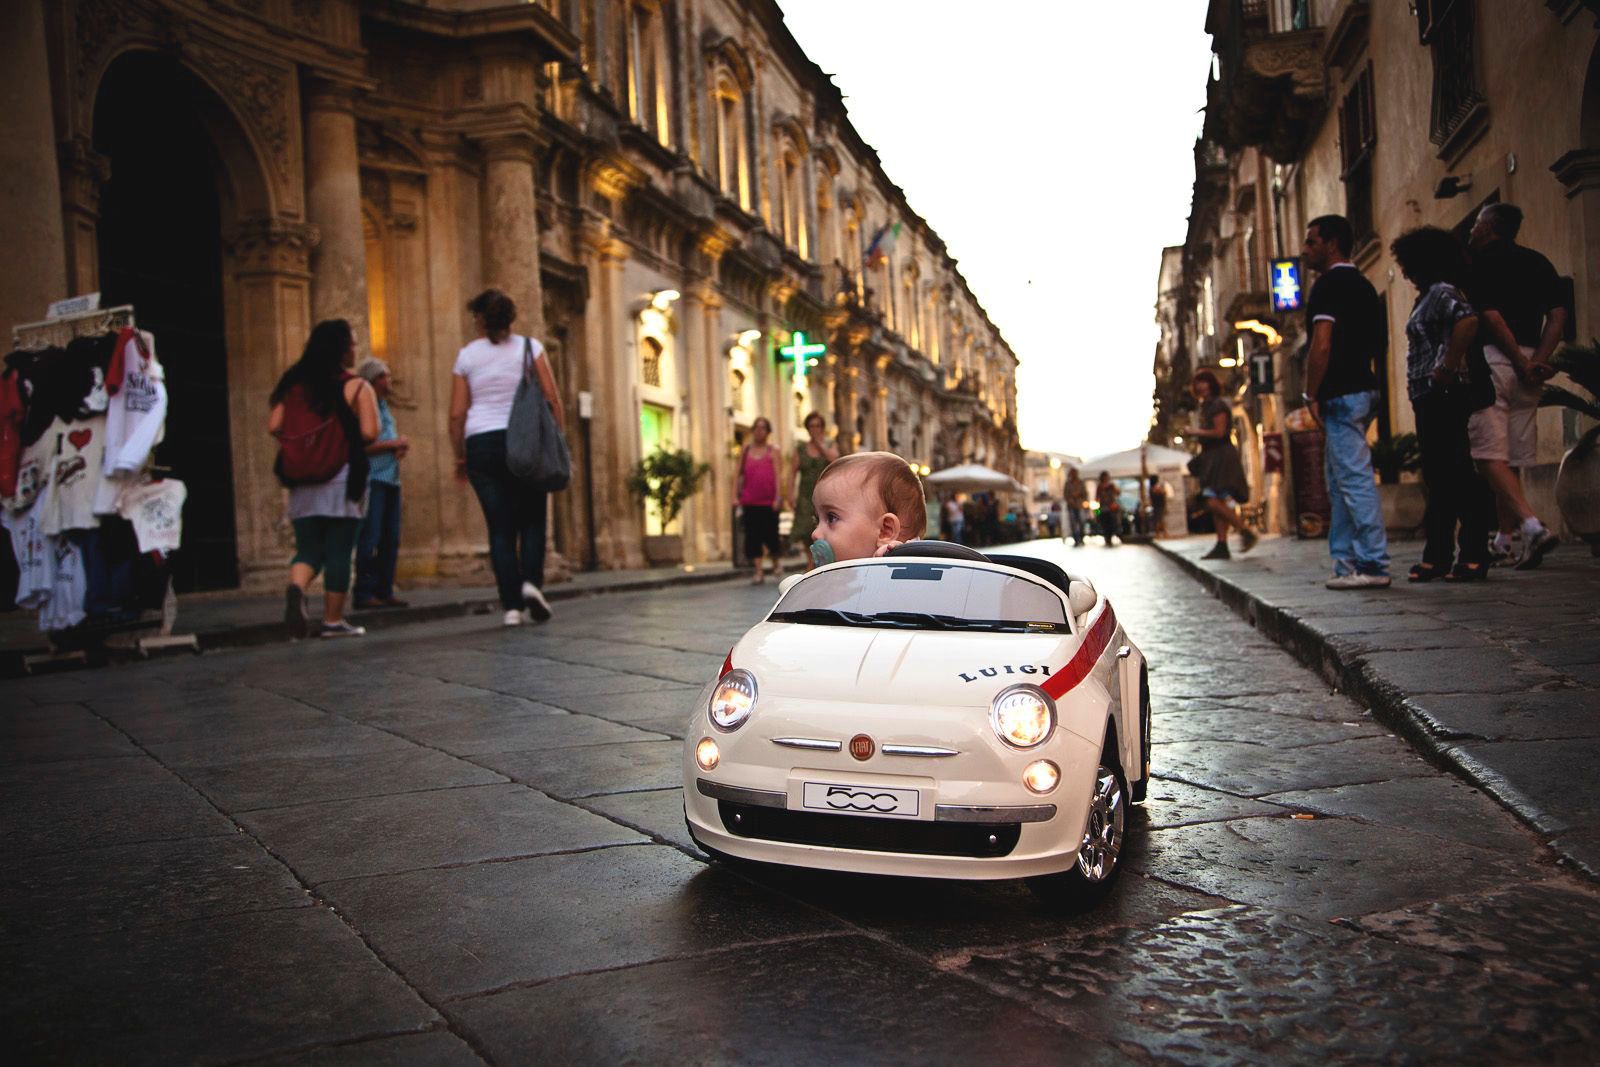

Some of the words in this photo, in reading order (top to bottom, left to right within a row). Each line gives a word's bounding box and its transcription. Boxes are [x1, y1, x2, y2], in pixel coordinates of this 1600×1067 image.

[958, 664, 1051, 683] LUIGI
[855, 741, 869, 753] FIAT
[826, 786, 898, 812] 500
